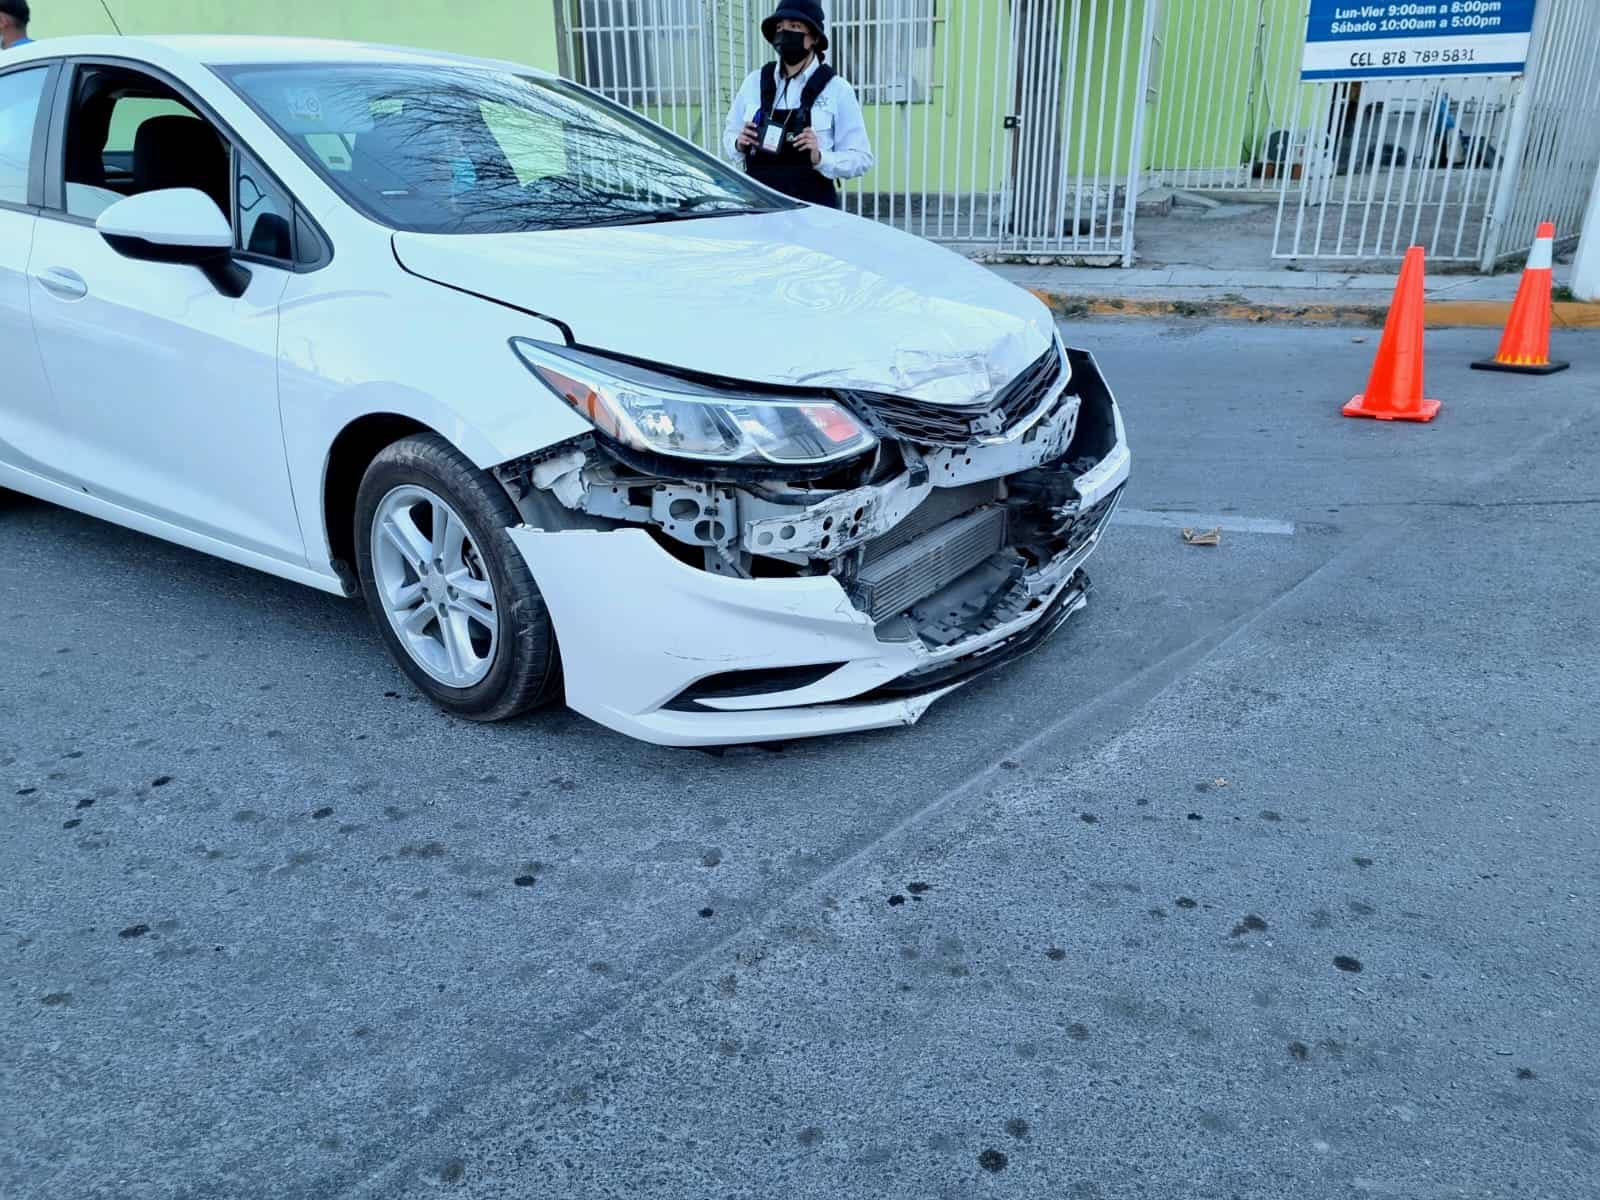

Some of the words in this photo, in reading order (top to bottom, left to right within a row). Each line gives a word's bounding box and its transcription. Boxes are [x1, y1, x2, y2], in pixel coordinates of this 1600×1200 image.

[1388, 4, 1436, 16] 9:00am
[1440, 4, 1447, 14] a
[1451, 1, 1501, 14] 8:00pm
[1331, 21, 1376, 33] Sábado
[1379, 18, 1436, 31] 10:00am
[1440, 19, 1447, 28] a
[1451, 15, 1501, 28] 5:00pm
[1382, 50, 1406, 65] 878
